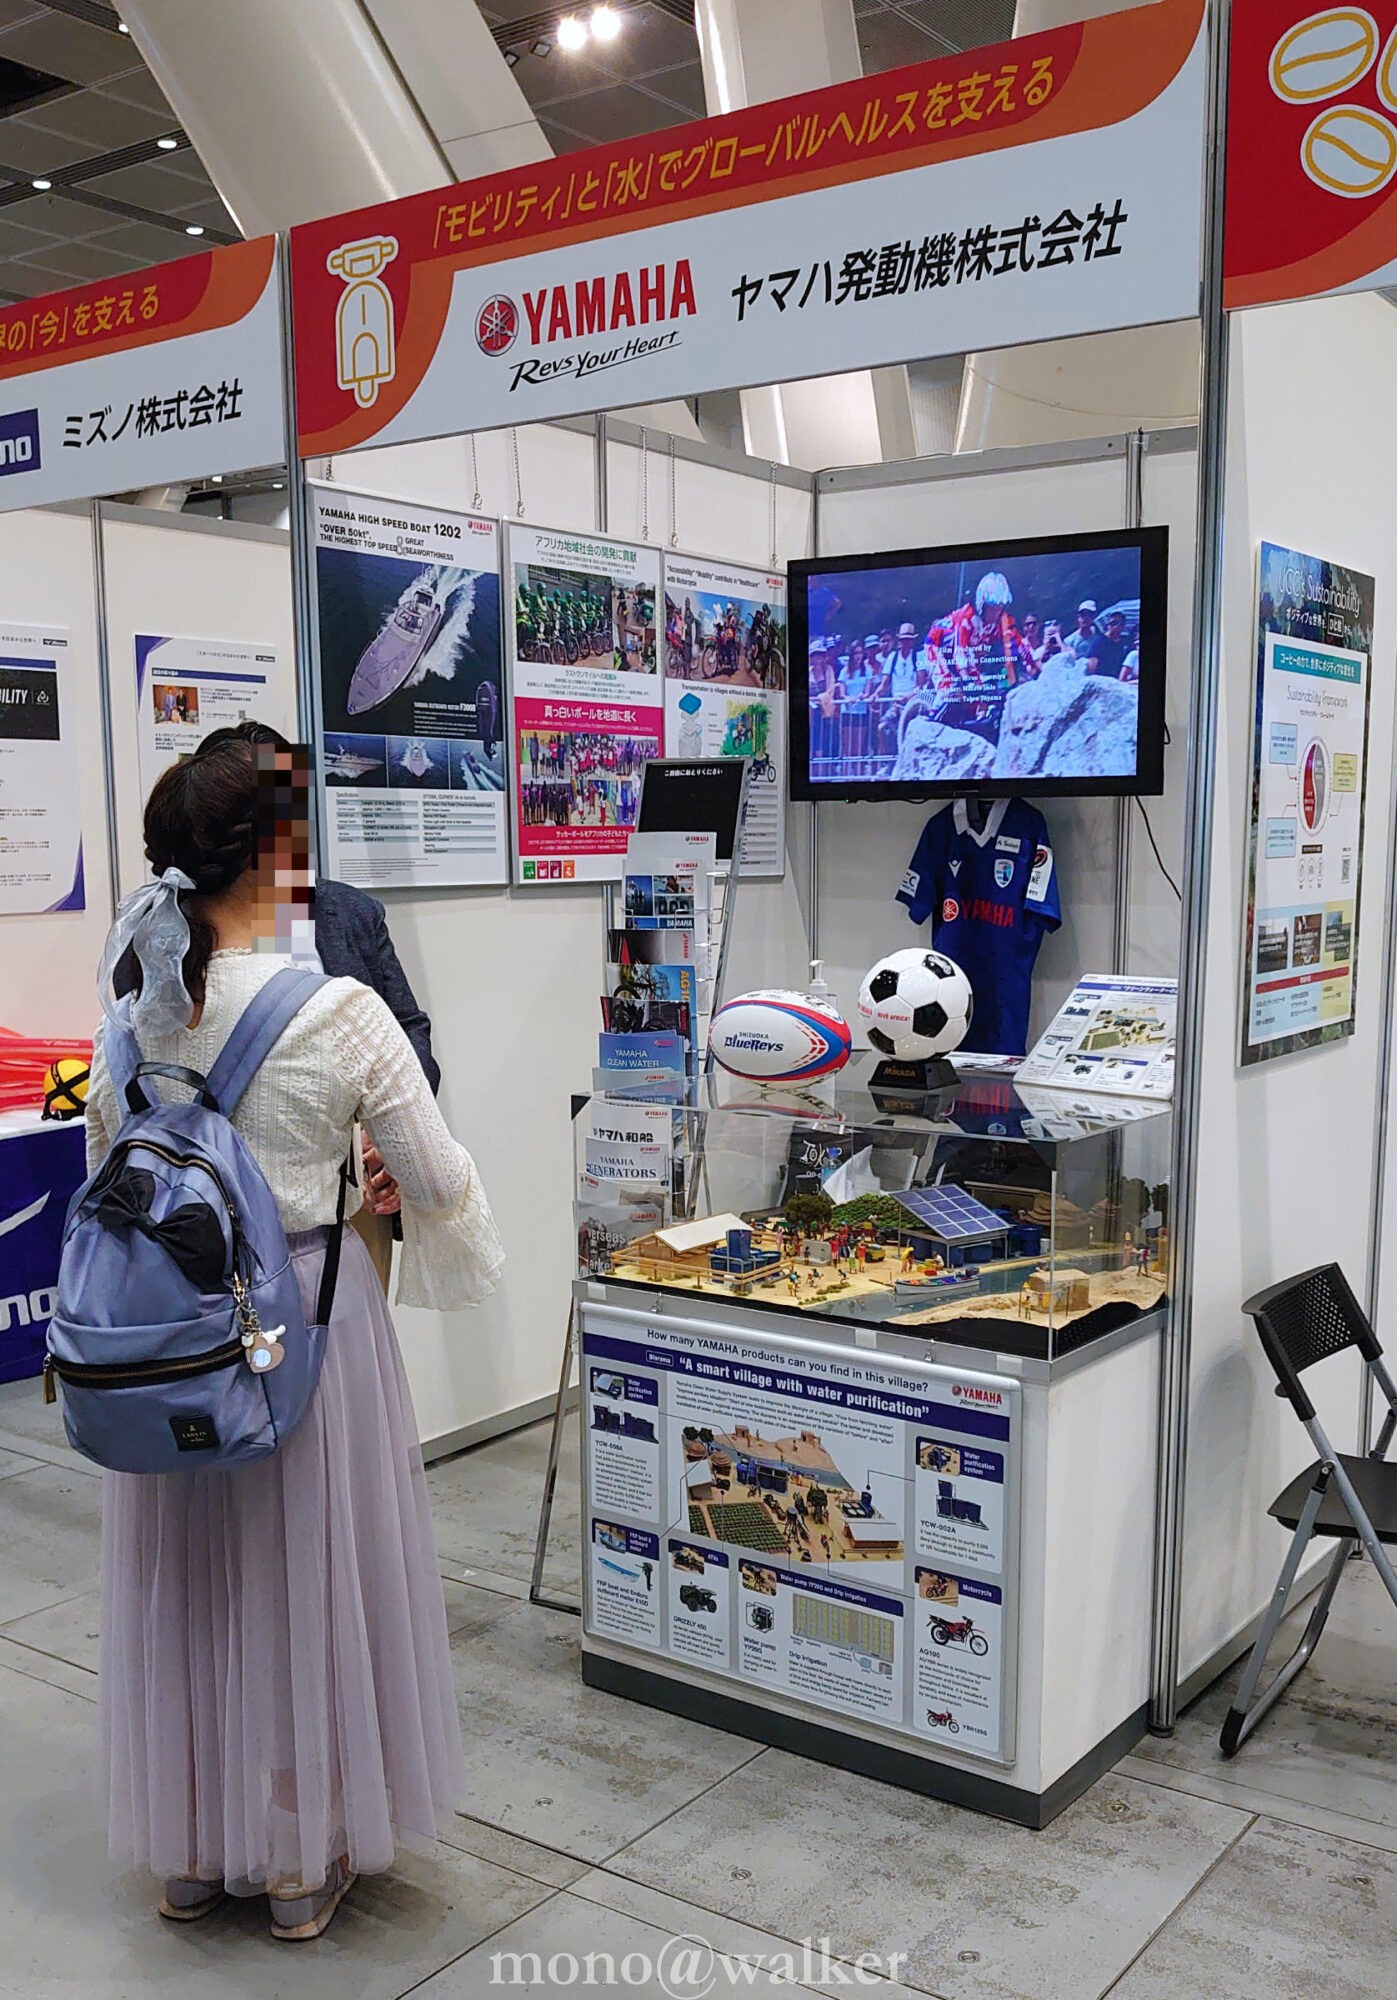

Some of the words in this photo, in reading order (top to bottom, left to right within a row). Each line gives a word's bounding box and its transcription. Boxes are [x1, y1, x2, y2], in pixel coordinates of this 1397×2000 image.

[433, 55, 1055, 249] 「モビリティ」と「水」でグローバルヘルスを支える
[730, 199, 1128, 321] ヤマハ発動機株式会社
[522, 258, 697, 345] YAMAHA
[508, 353, 574, 393] Revs
[573, 345, 626, 379] Your
[623, 330, 683, 359] Heart
[62, 377, 244, 449] ミズノ株式会社
[319, 506, 357, 522] YAMAHA
[358, 512, 381, 526] HIGH
[381, 518, 409, 530] SPEED
[410, 522, 431, 535] BOAT
[433, 523, 462, 540] 1202
[319, 533, 334, 543] THE
[334, 535, 362, 548] HIGHEST
[363, 539, 378, 549] TOP
[377, 541, 398, 552] SPEED
[405, 537, 425, 547] GREAT
[535, 535, 638, 563] アフリカ地域社会の開発に貢献
[1307, 574, 1361, 619] Sustainability
[666, 919, 693, 927] YAMAHA
[961, 899, 1015, 928] YAMAHA
[739, 1031, 770, 1040] SHIZUOKA
[614, 1049, 648, 1058] YAMAHA
[629, 1059, 660, 1068] WATER
[598, 1127, 654, 1143] ヤマハ和船
[586, 1163, 657, 1178] GENERATORS
[599, 1156, 635, 1166] YAMAHA
[647, 1328, 668, 1341] How
[669, 1334, 695, 1348] many
[696, 1337, 740, 1355] YAMAHA
[741, 1347, 786, 1365] products
[787, 1357, 807, 1369] can
[808, 1362, 827, 1373] you
[829, 1364, 850, 1377] find
[851, 1367, 863, 1379] in
[865, 1370, 885, 1384] this
[887, 1375, 929, 1393] village?
[679, 1357, 694, 1371] “A
[696, 1362, 731, 1380] smart
[733, 1368, 773, 1388] village
[775, 1377, 803, 1394] with
[806, 1384, 843, 1401] water
[846, 1392, 930, 1418] purification”
[962, 1386, 1003, 1405] YAMAHA
[963, 1451, 980, 1460] Water
[963, 1459, 996, 1471] purification
[963, 1466, 984, 1476] system
[962, 1583, 992, 1597] Motorcycle
